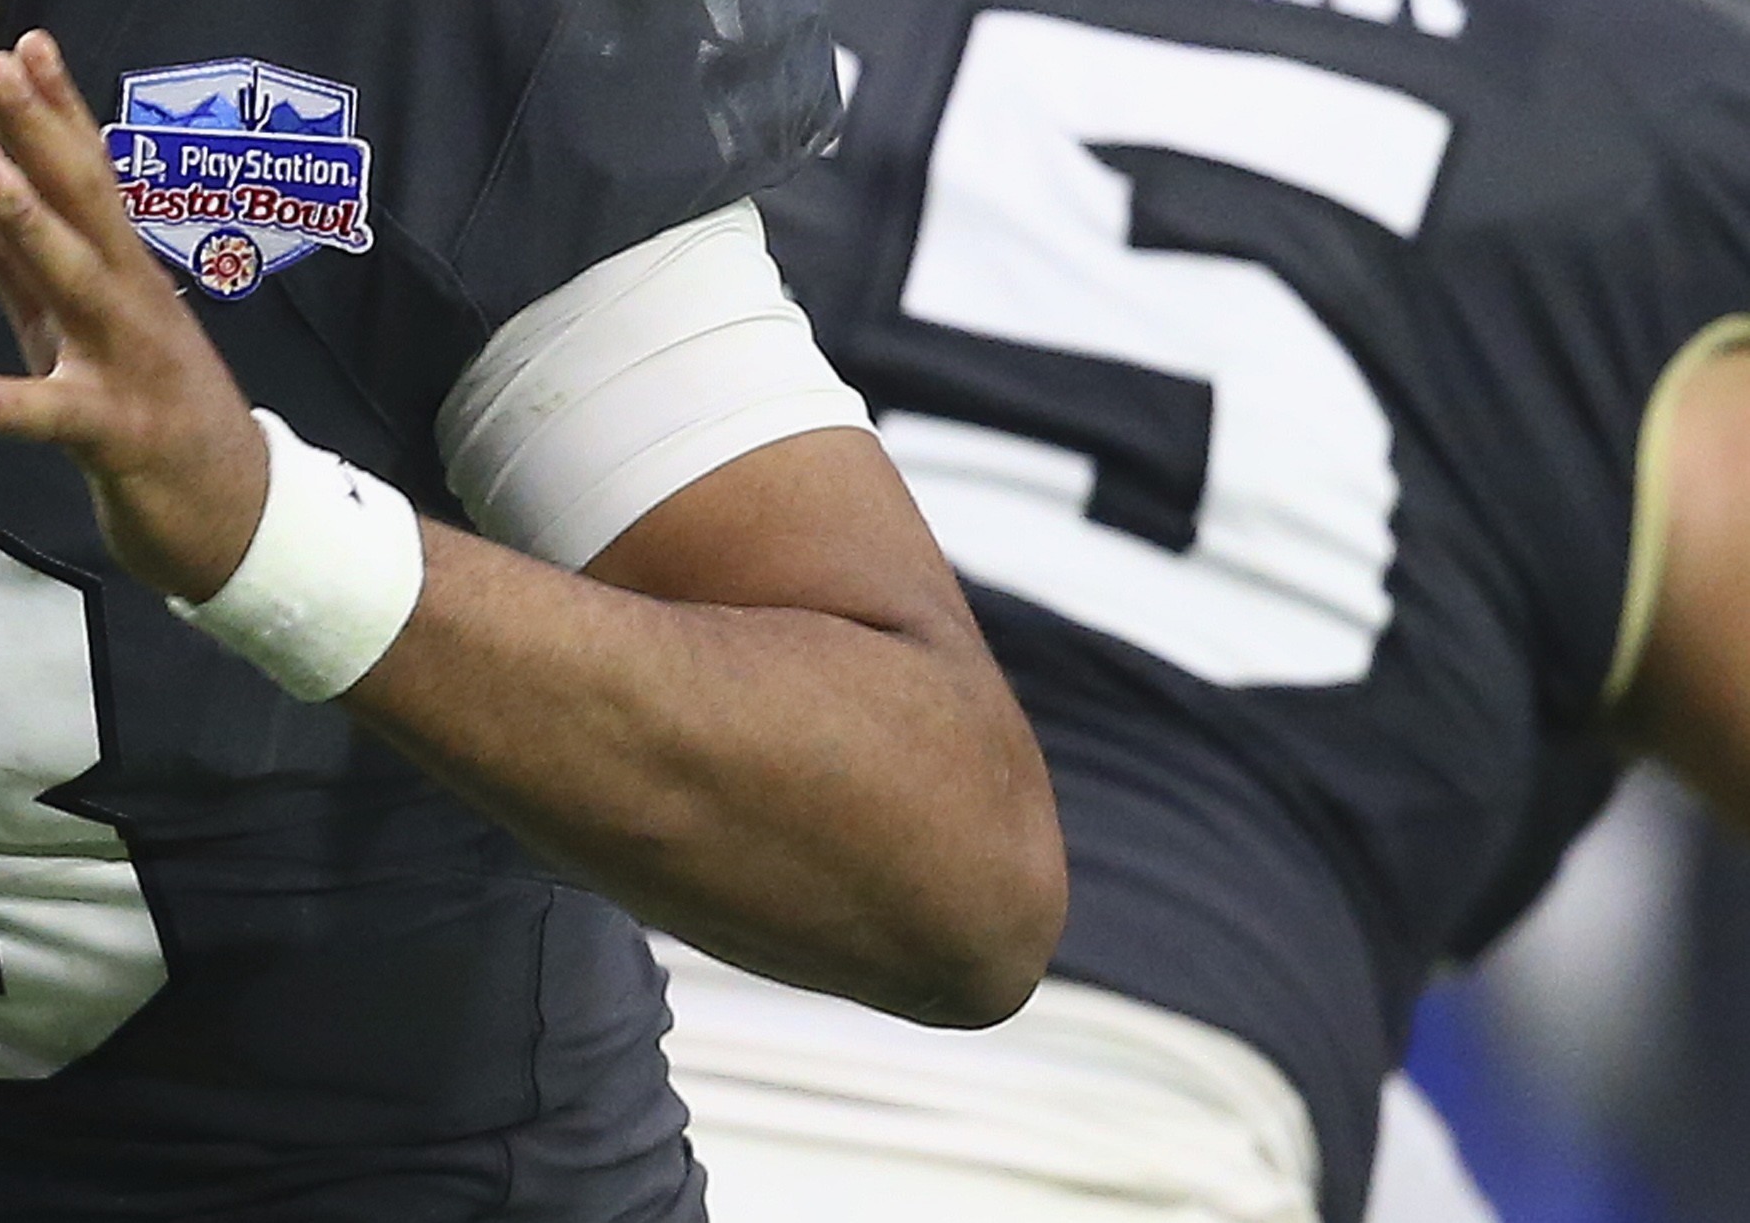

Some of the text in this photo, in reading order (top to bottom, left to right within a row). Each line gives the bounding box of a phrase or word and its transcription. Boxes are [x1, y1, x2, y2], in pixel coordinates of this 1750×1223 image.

[180, 145, 349, 188] PlayStation
[119, 180, 361, 239] iesta Bowl
[820, 7, 1456, 692] 5
